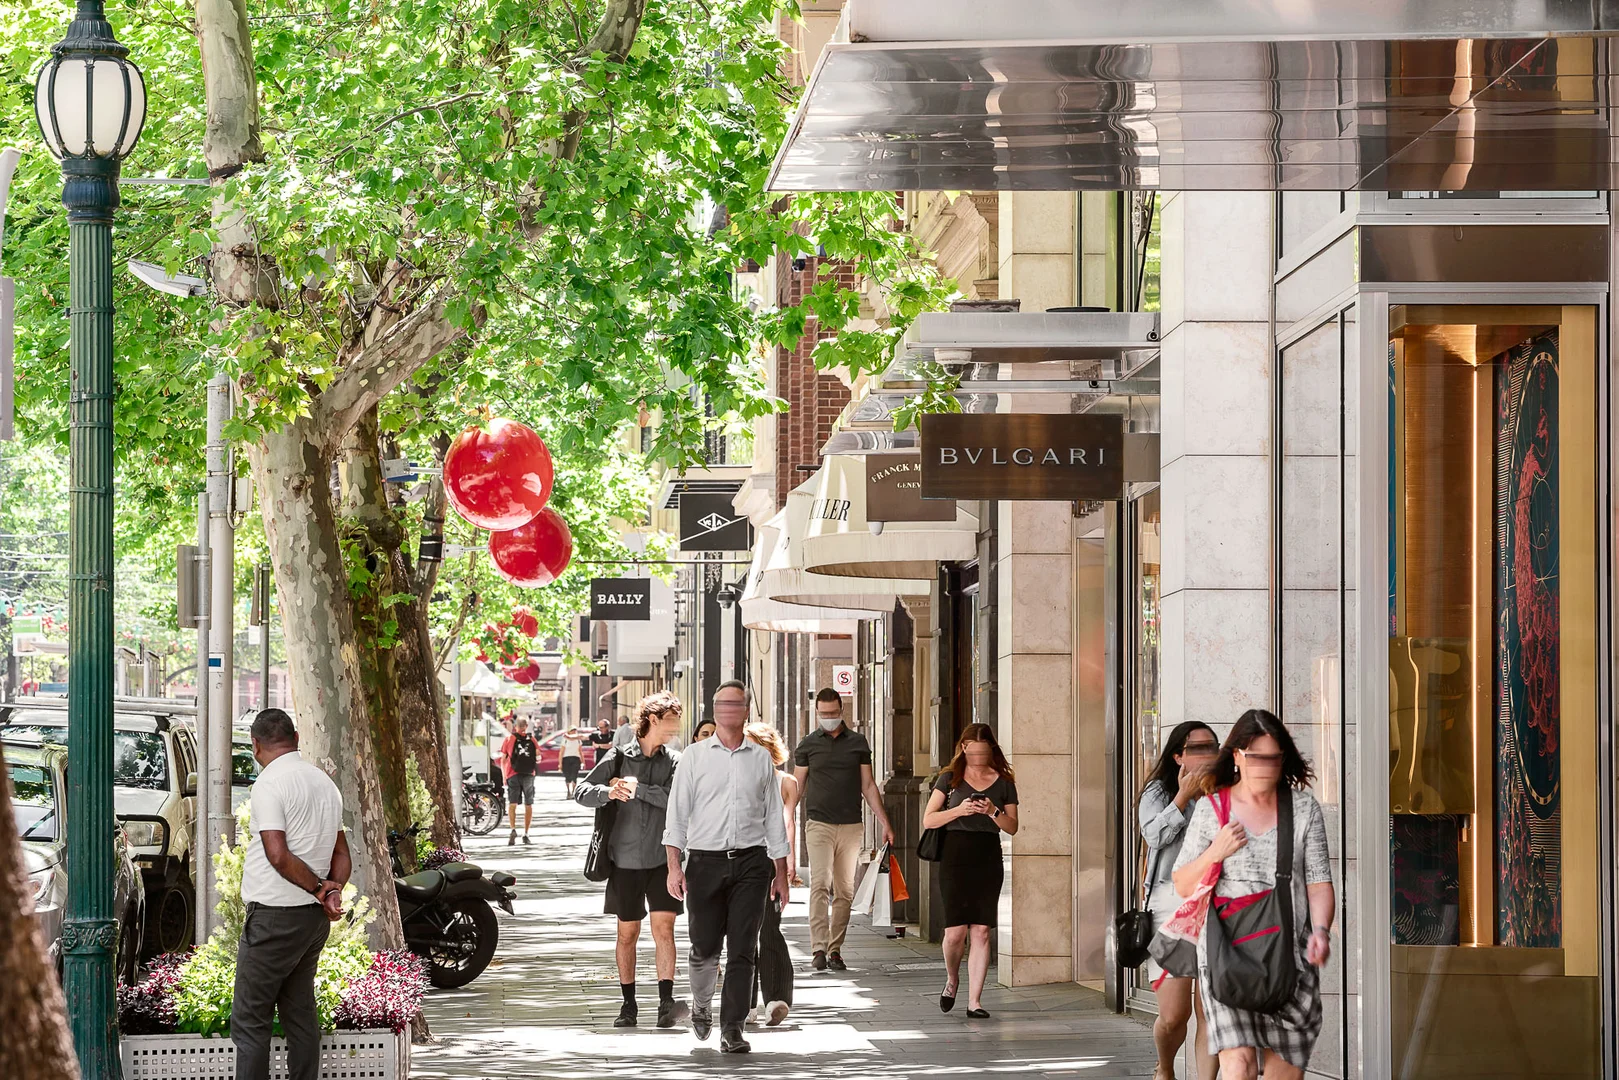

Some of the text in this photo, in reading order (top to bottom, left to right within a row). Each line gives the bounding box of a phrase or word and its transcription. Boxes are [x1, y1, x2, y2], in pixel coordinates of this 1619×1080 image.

[939, 447, 1106, 466] BVLGARI
[871, 463, 910, 483] FRANCK
[597, 594, 644, 605] BALLY
